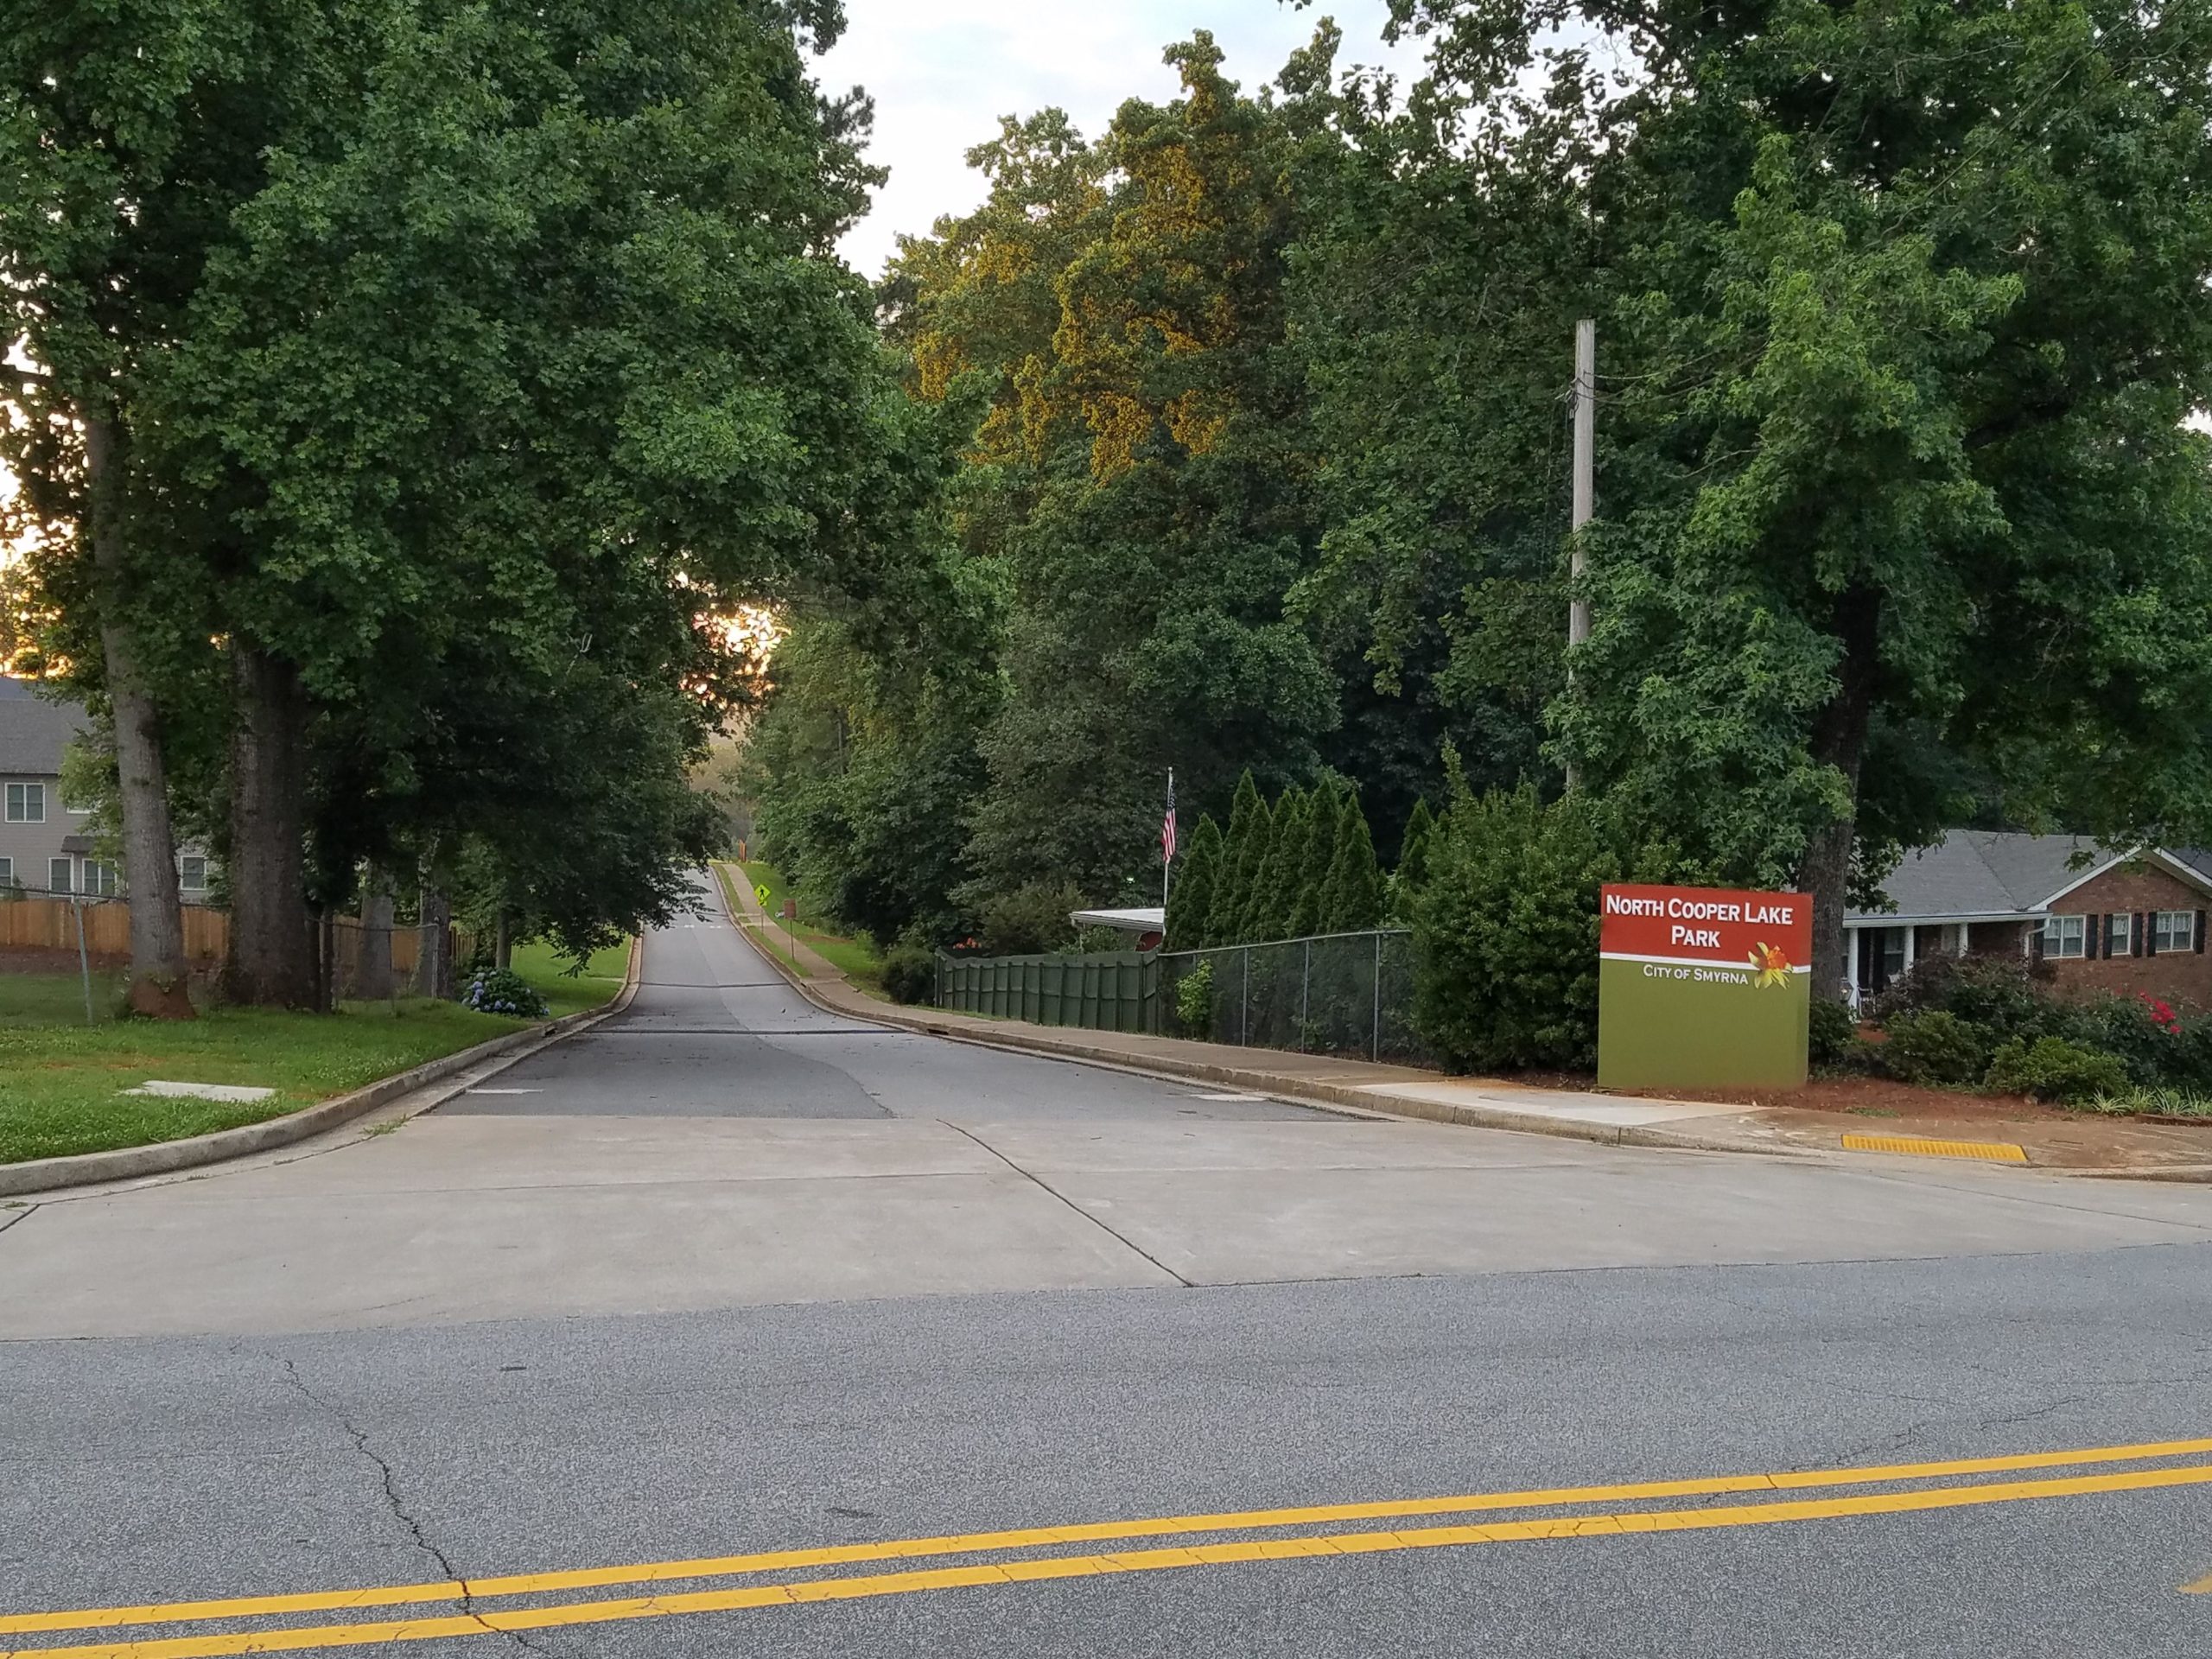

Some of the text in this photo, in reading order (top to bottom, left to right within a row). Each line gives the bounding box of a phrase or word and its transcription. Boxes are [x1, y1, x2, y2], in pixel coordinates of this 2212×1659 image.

[1606, 894, 1793, 925] NORTH COOPER LAKE
[1671, 925, 1720, 948] PARK
[1643, 964, 1748, 985] CITY OF SMYRNA
